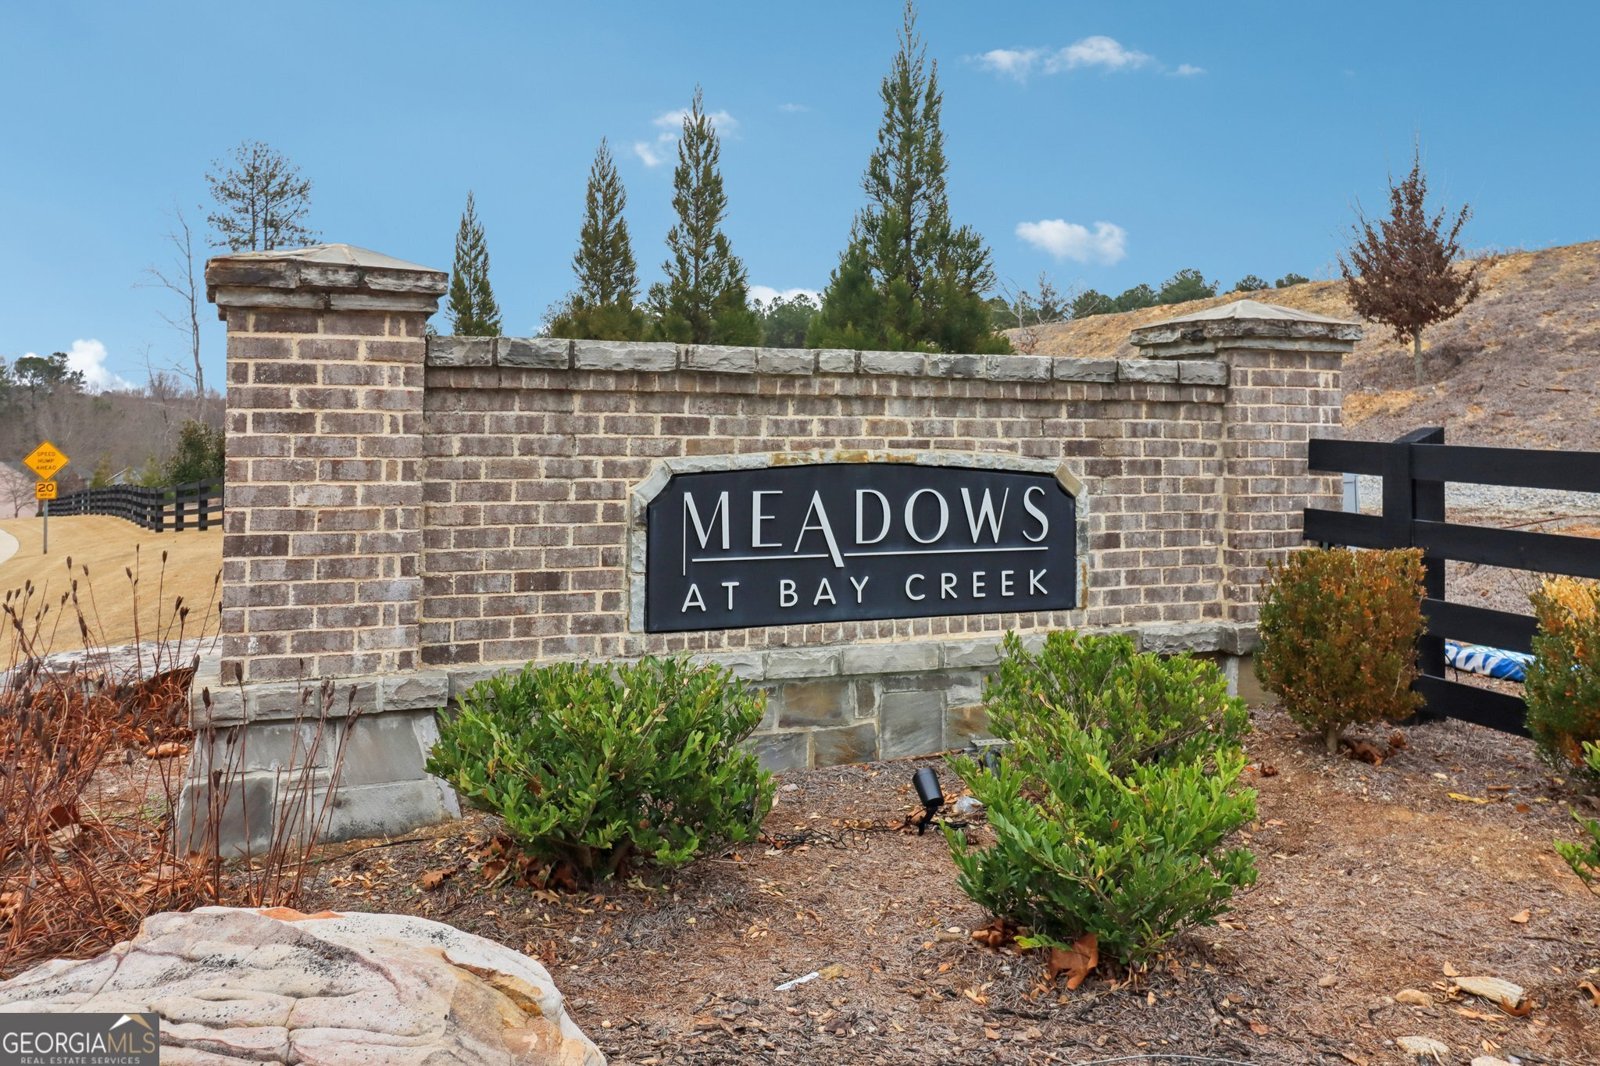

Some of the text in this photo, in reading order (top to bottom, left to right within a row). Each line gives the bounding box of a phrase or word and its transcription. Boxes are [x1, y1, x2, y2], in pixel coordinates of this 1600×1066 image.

[38, 483, 55, 492] 20
[683, 486, 1049, 576] MEADOWS
[681, 568, 1048, 613] AT BAY CREEK
